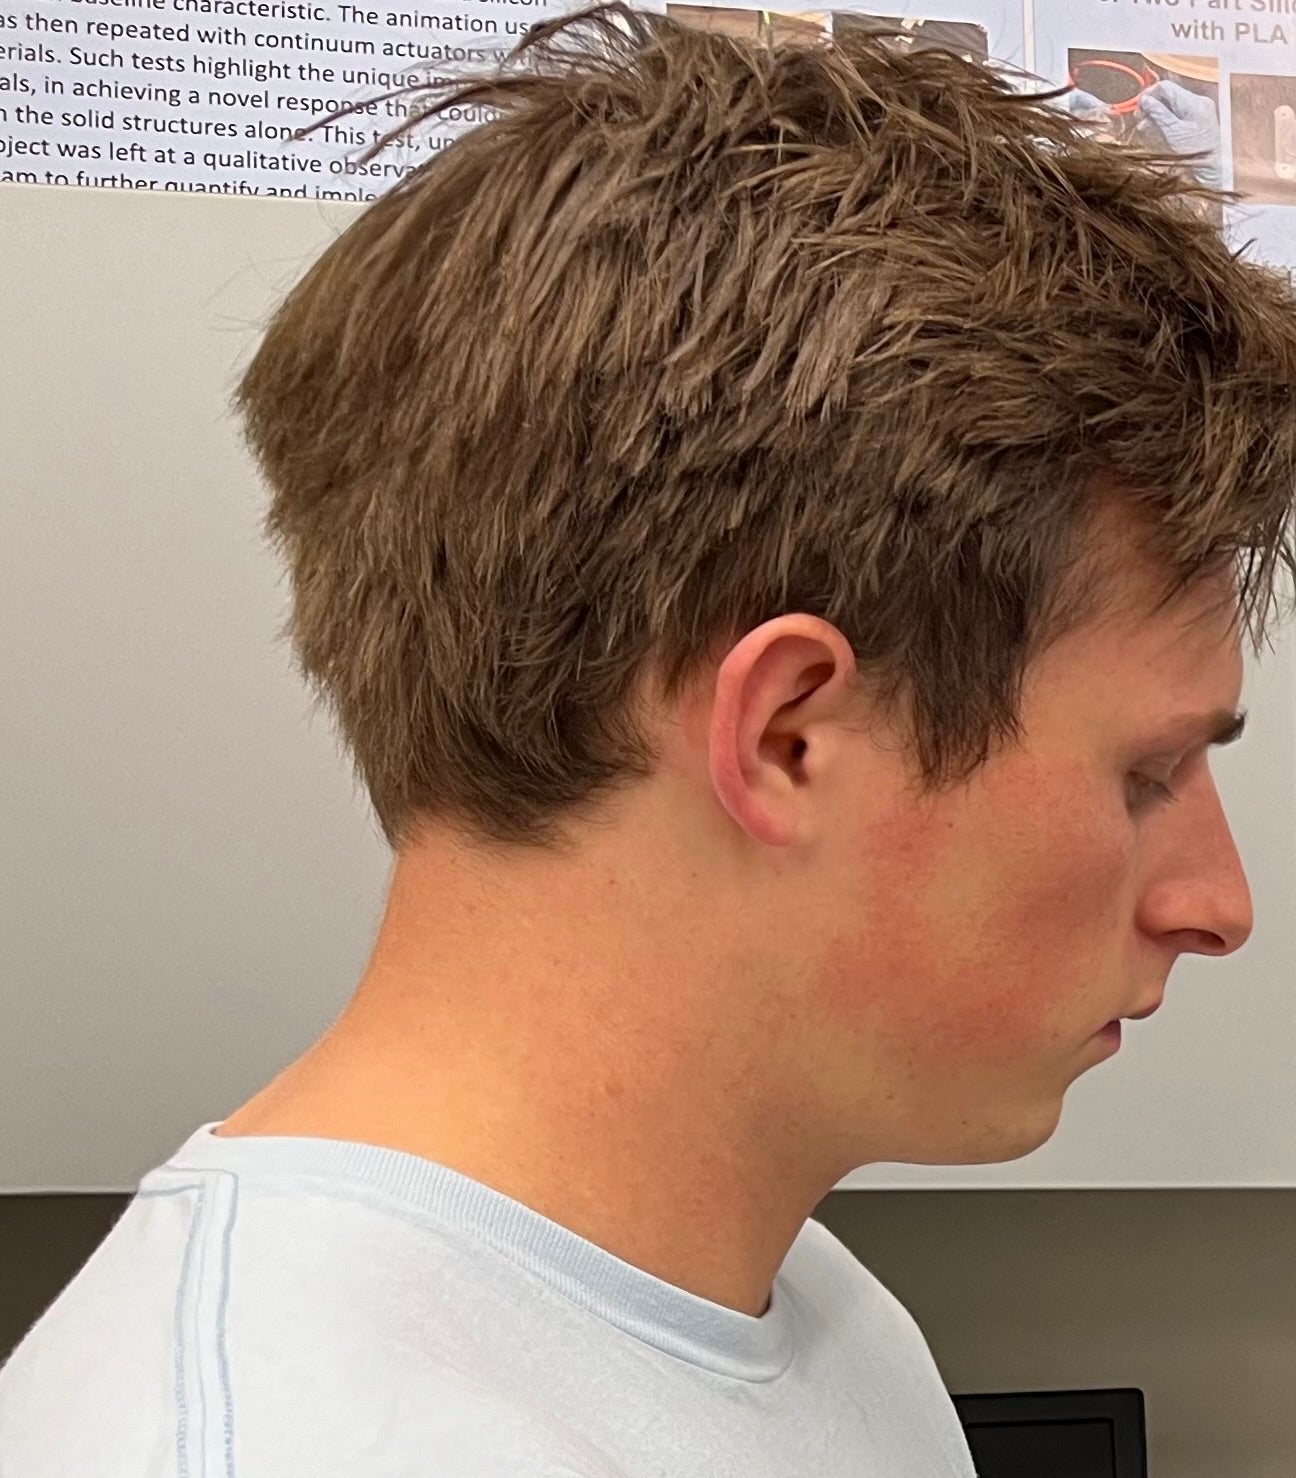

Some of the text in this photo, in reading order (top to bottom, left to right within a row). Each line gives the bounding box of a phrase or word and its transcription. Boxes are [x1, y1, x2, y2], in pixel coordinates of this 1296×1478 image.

[339, 5, 378, 25] The
[386, 10, 497, 33] animation
[1171, 21, 1224, 42] with
[1234, 23, 1288, 45] PLA
[26, 14, 78, 35] then
[87, 21, 190, 41] repeated
[197, 27, 246, 46] with
[254, 34, 375, 55] continuum
[382, 41, 486, 63] actuators
[70, 46, 123, 68] Such
[132, 52, 186, 73] tests
[193, 55, 292, 82] highlight
[299, 64, 335, 82] the
[342, 69, 420, 90] unique
[44, 76, 378, 118] in achieving a novel response
[16, 106, 366, 145] the solid structures This
[57, 142, 323, 174] was left at a qualitative
[77, 171, 159, 191] further
